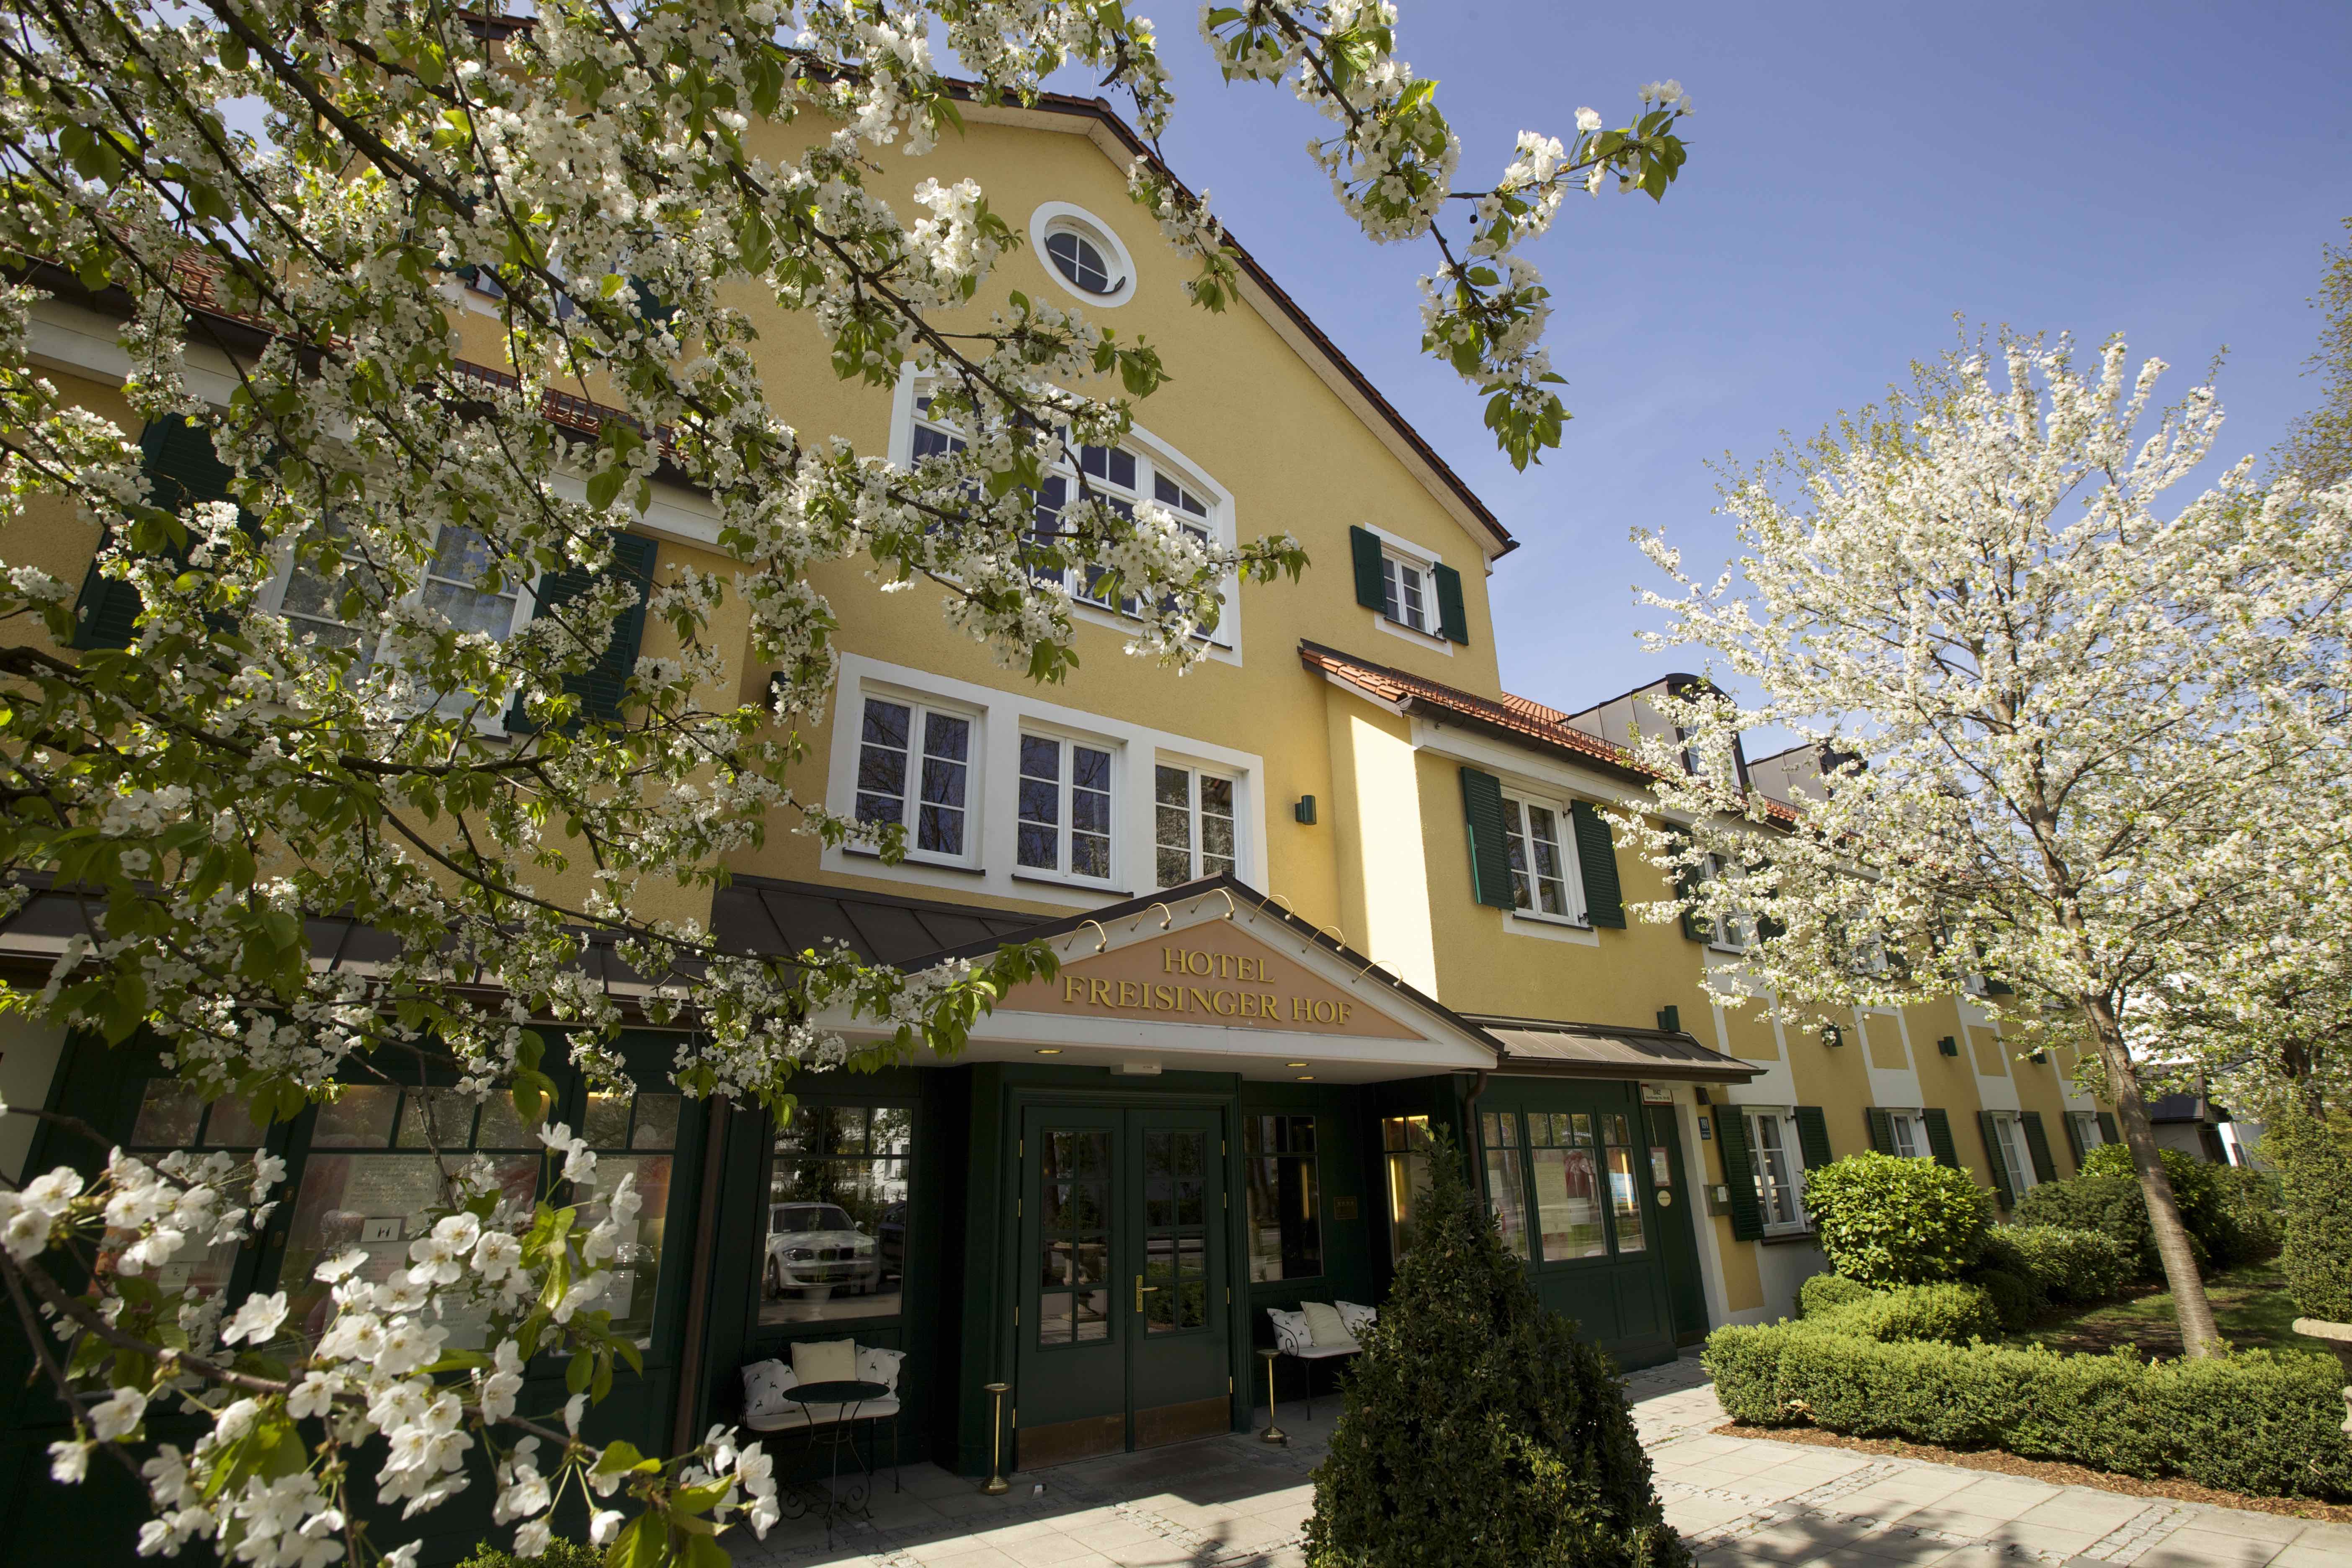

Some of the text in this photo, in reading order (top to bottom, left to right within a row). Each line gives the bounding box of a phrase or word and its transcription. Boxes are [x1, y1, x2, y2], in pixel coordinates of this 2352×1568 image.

[1163, 947, 1276, 983] HOTEL
[1063, 975, 1353, 1025] FREISINGER HOF
[1700, 1119, 1709, 1129] 191
